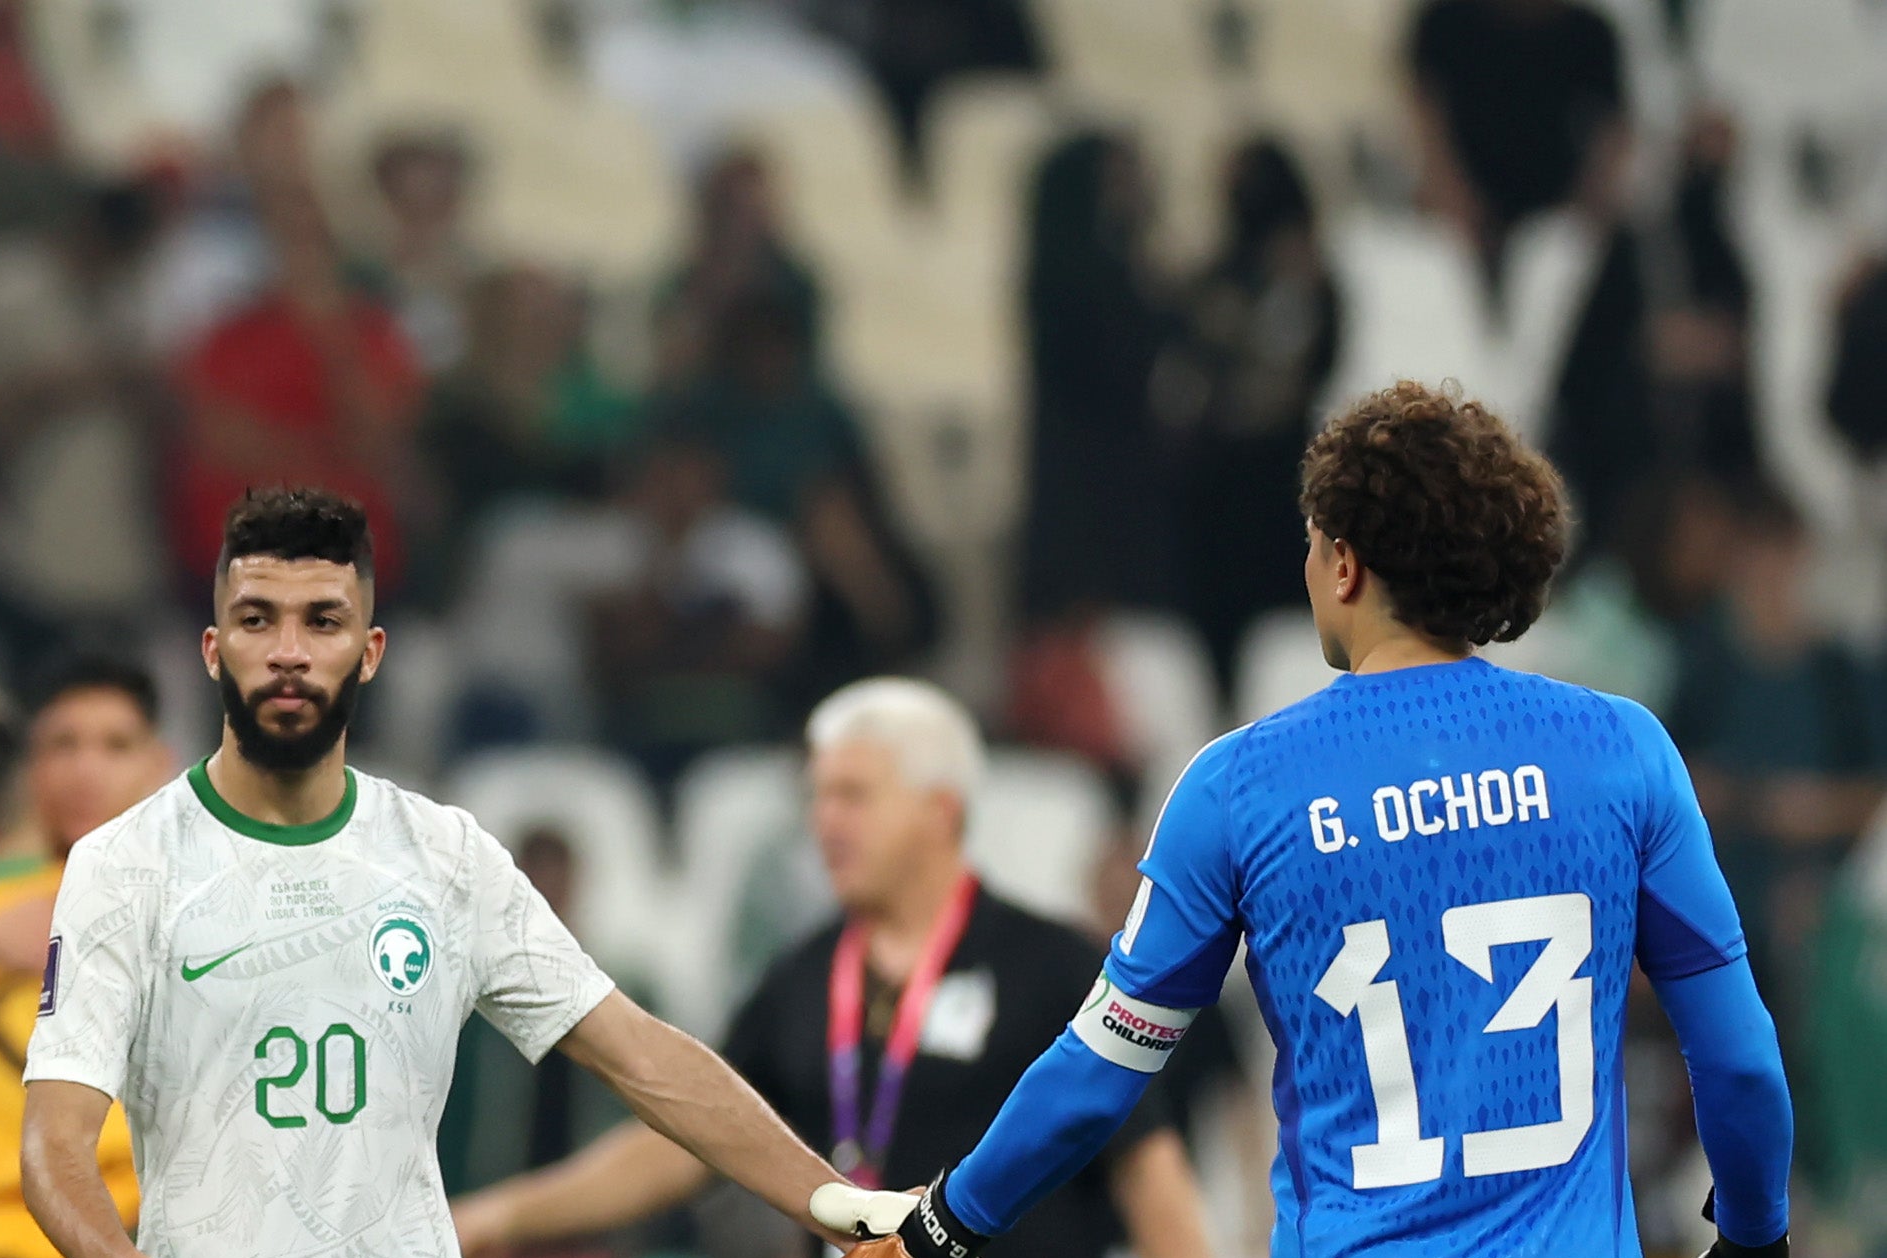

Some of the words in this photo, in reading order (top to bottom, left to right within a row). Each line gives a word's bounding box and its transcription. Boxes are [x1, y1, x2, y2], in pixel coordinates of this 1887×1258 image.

[1308, 796, 1360, 854] G.
[1372, 764, 1551, 843] OCHOA
[1102, 1014, 1178, 1051] CHILDRE
[1108, 1000, 1187, 1039] PROTEC
[1313, 892, 1594, 1190] 13
[255, 1023, 367, 1129] 20
